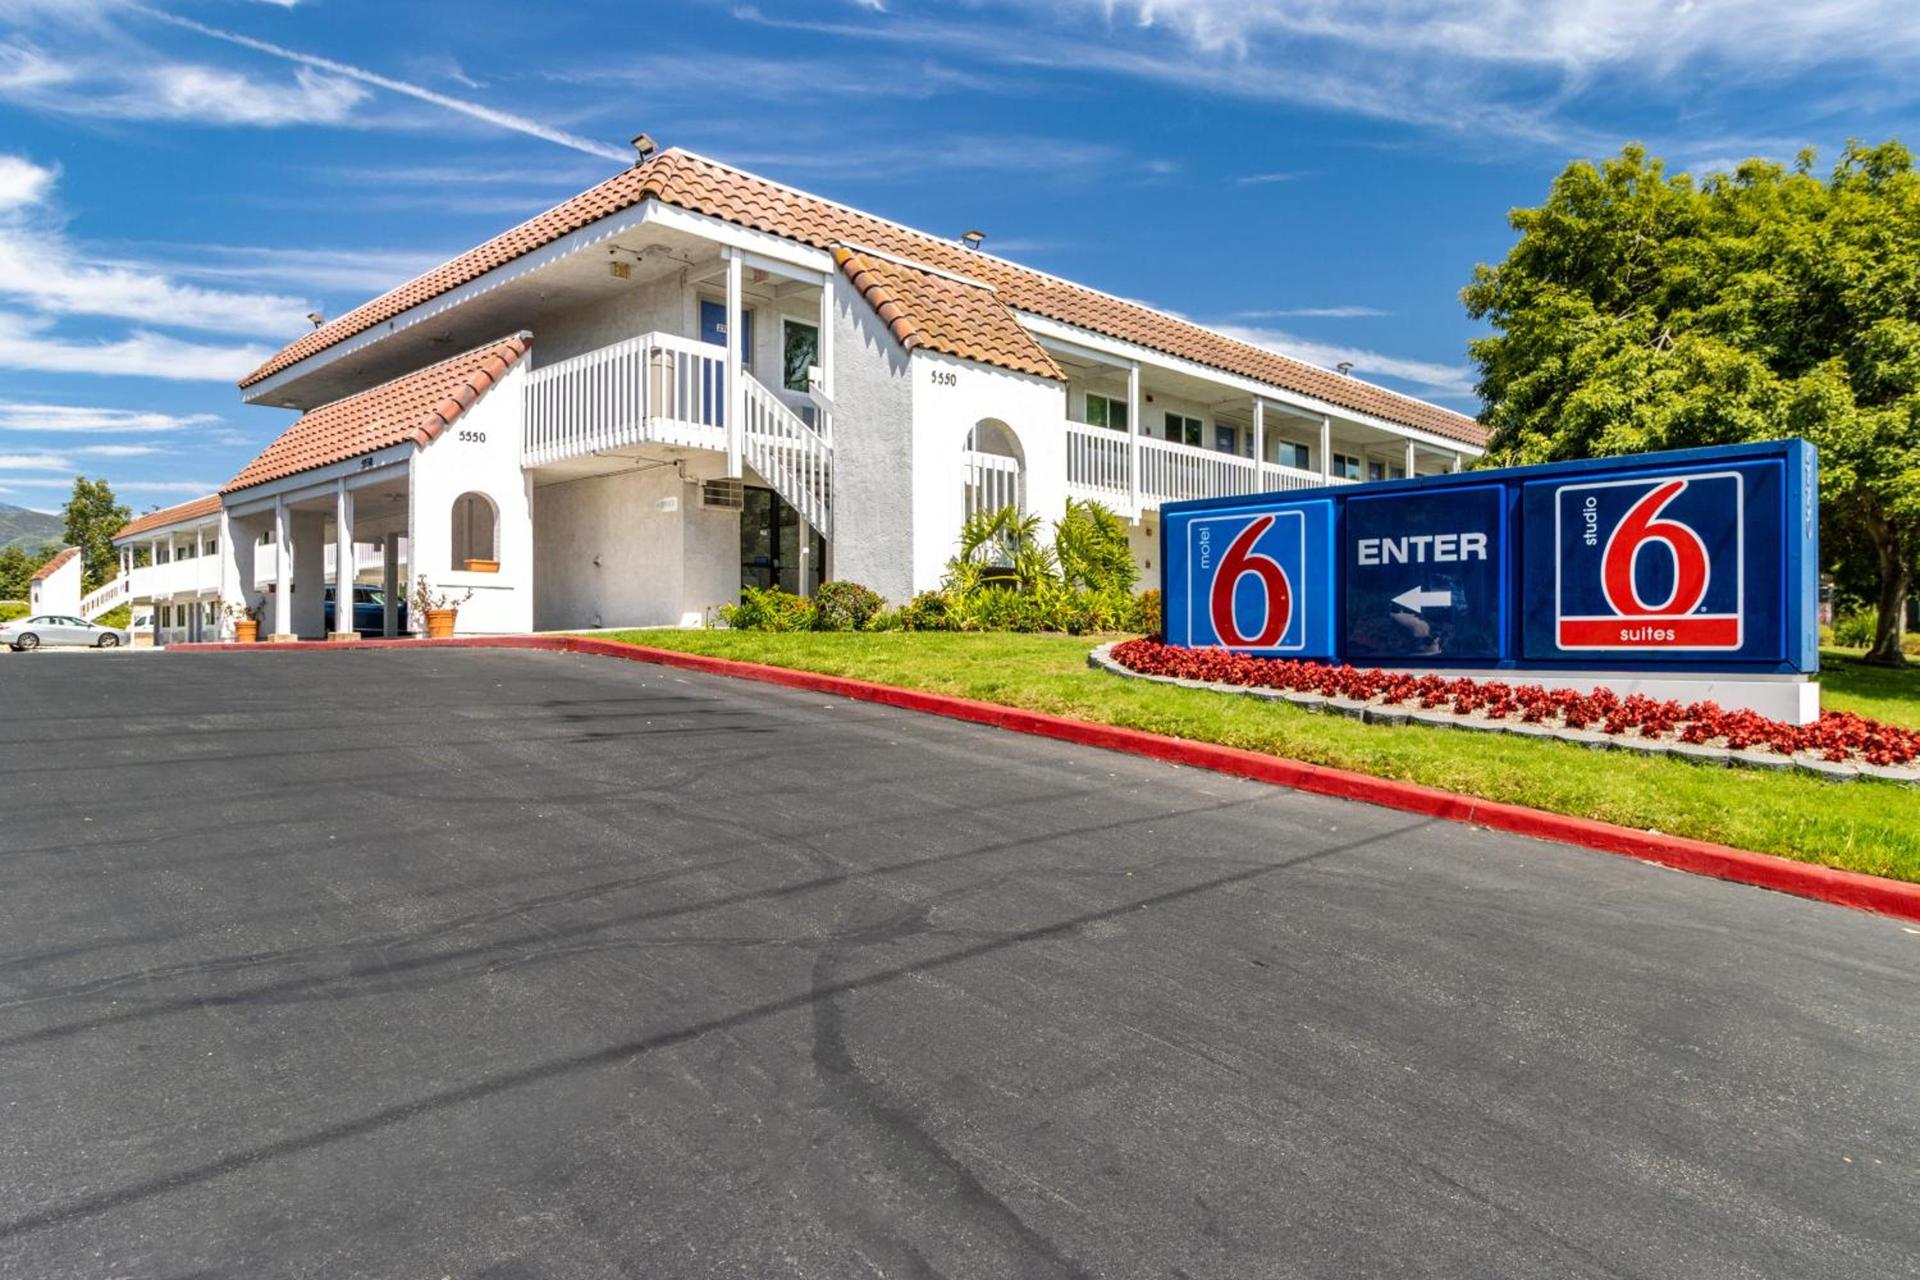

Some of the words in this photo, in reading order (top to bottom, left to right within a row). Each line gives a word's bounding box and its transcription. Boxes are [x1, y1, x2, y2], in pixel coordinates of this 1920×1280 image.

[930, 370, 957, 387] 5550
[458, 430, 487, 443] 5550
[1583, 496, 1597, 546] studio
[1199, 527, 1210, 569] motel
[1358, 532, 1488, 566] ENTER
[1600, 479, 1711, 617] 6
[1209, 515, 1293, 648] 6
[1619, 626, 1676, 642] suites
